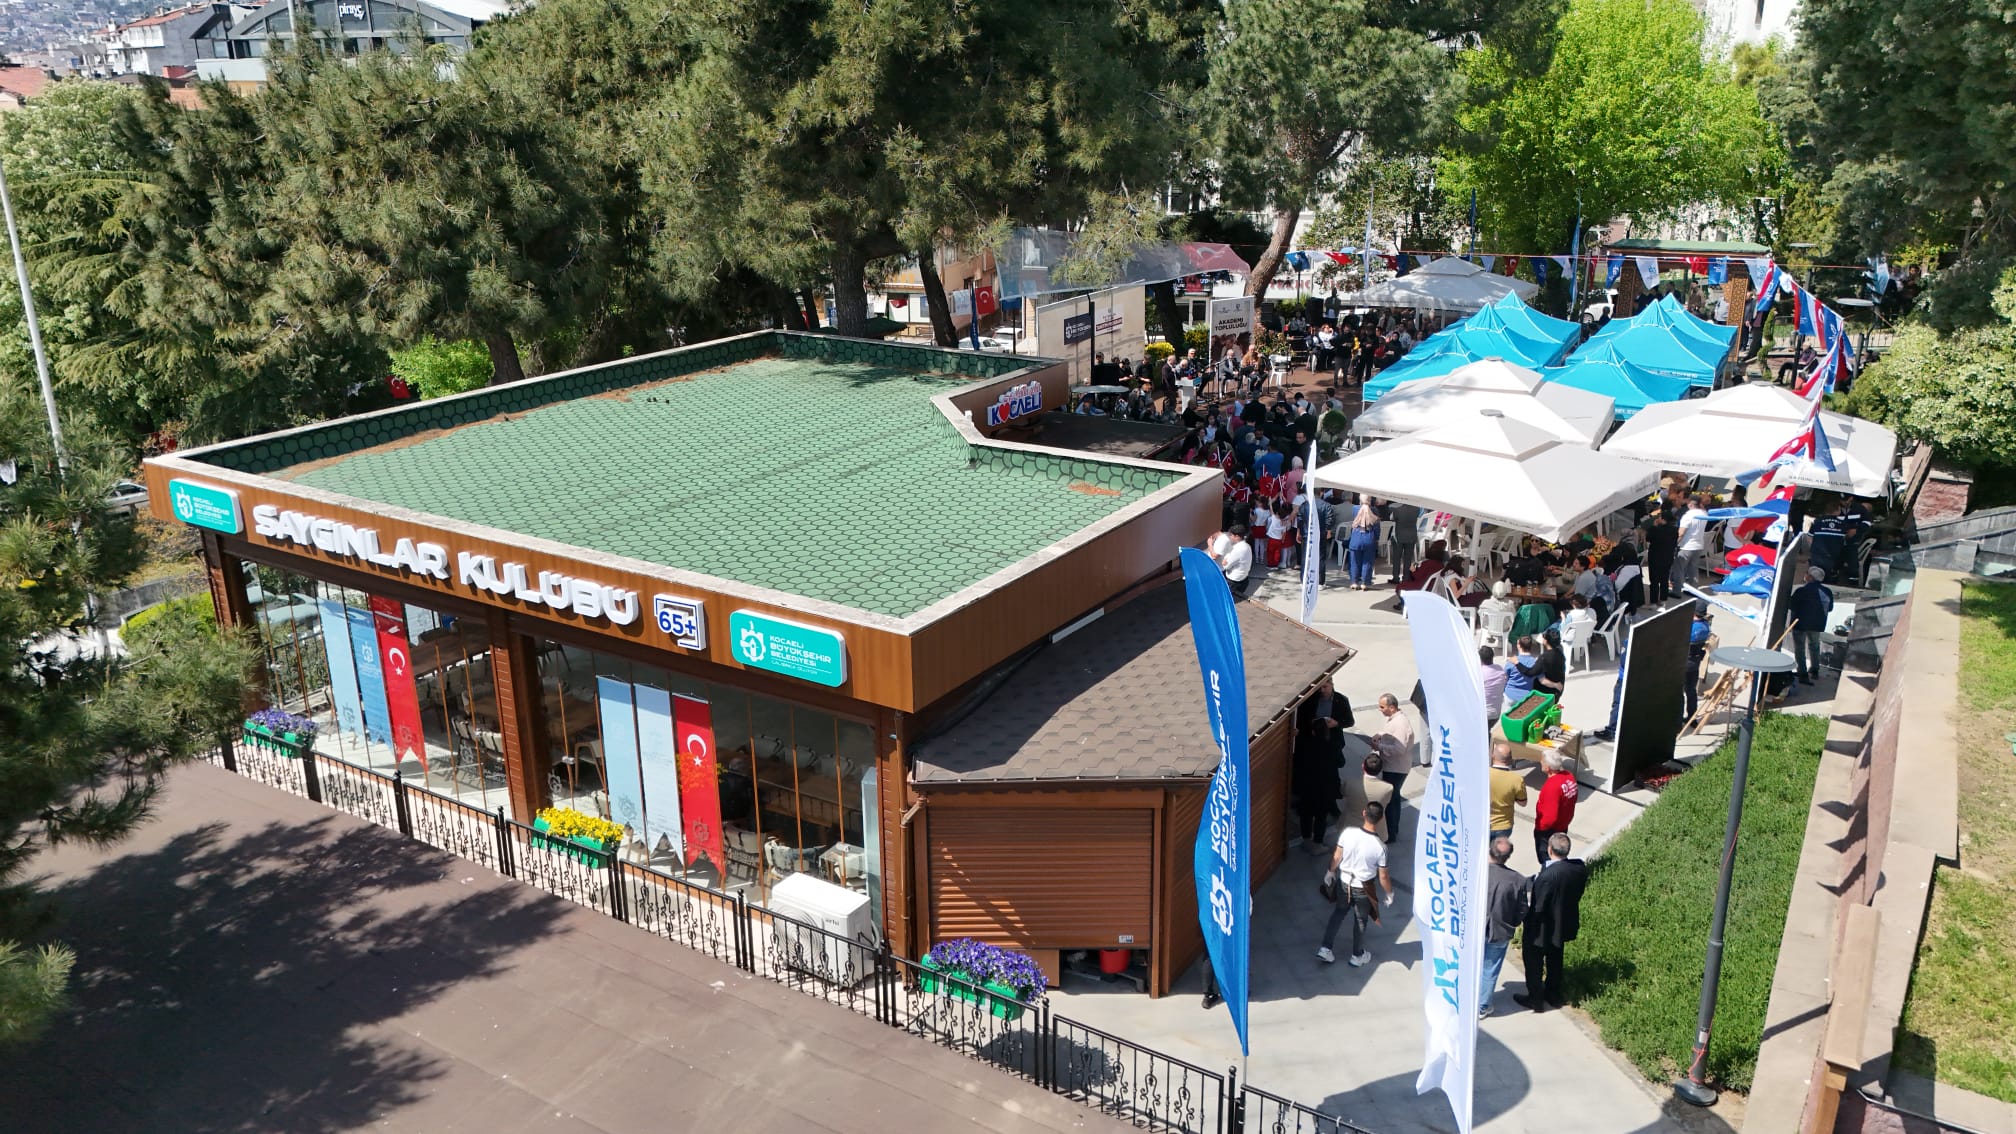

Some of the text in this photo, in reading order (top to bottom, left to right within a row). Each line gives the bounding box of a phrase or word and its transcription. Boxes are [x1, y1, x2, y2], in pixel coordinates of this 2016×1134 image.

[253, 505, 638, 626] SAYGINLAR KULÜBÜ
[658, 610, 697, 635] 65+
[769, 635, 804, 648] KOCAELİ
[770, 651, 817, 666] BELEDİYESİ
[1425, 813, 1446, 933] KOCAELİ
